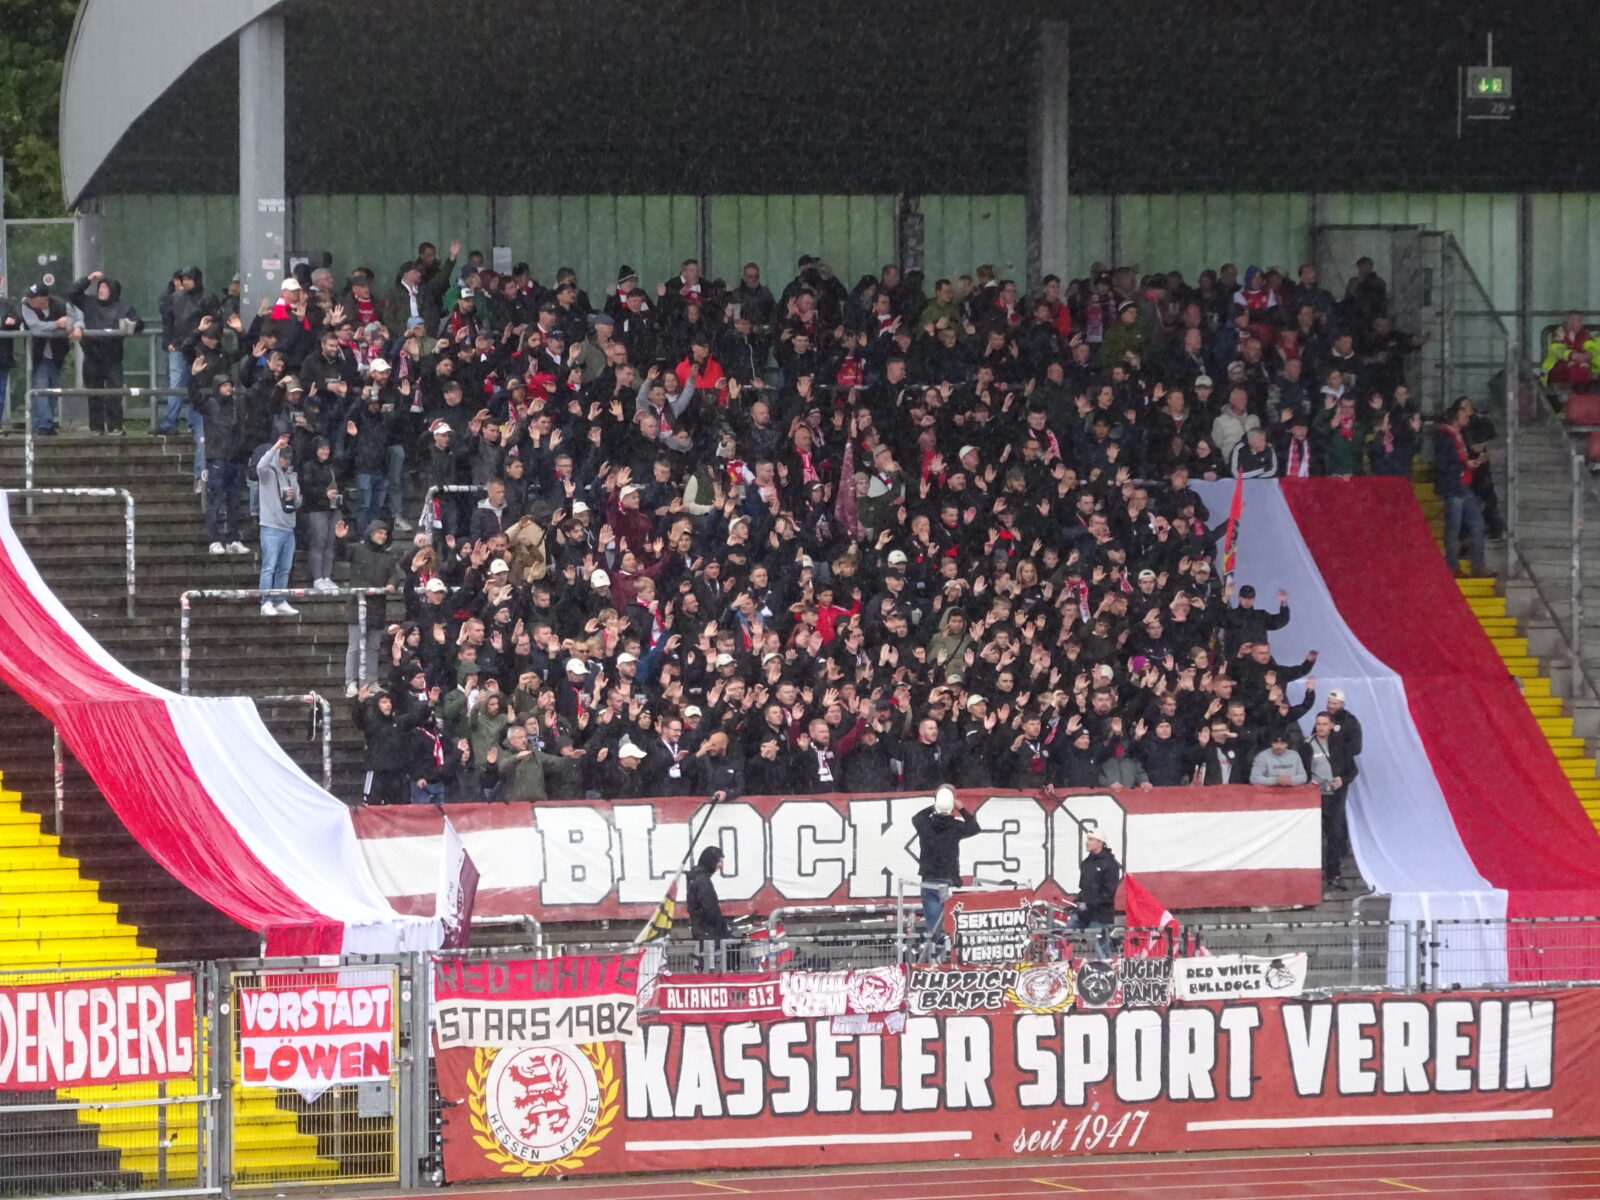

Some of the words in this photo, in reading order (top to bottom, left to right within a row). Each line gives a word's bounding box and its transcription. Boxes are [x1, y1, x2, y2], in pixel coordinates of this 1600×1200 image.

[532, 796, 936, 906] BLOCK
[973, 796, 1128, 896] 30
[957, 910, 1026, 929] SEKTION
[961, 944, 1025, 961] VERBOT
[434, 953, 639, 993] RED-WHITE
[1119, 958, 1171, 980] JUGEND
[1187, 967, 1213, 978] RED
[1218, 965, 1261, 976] WHITE
[911, 971, 1018, 990] HUDDICH
[1189, 980, 1260, 994] BULLDOGS
[748, 986, 774, 1006] 913
[920, 990, 1002, 1009] BANDE
[1123, 982, 1168, 1003] BANDE
[242, 987, 389, 1030] VORSTADT
[439, 1007, 550, 1042] STARS
[555, 1002, 635, 1038] 1982
[243, 1038, 390, 1082] LÖWEN
[624, 1013, 993, 1119] KASSELER
[1015, 1005, 1261, 1108] SPORT
[1281, 999, 1556, 1096] VEREIN
[489, 1113, 540, 1160] HESSEN
[560, 1094, 599, 1154] KASSEL
[1013, 1118, 1068, 1153] seit
[1070, 1110, 1149, 1150] 1947
